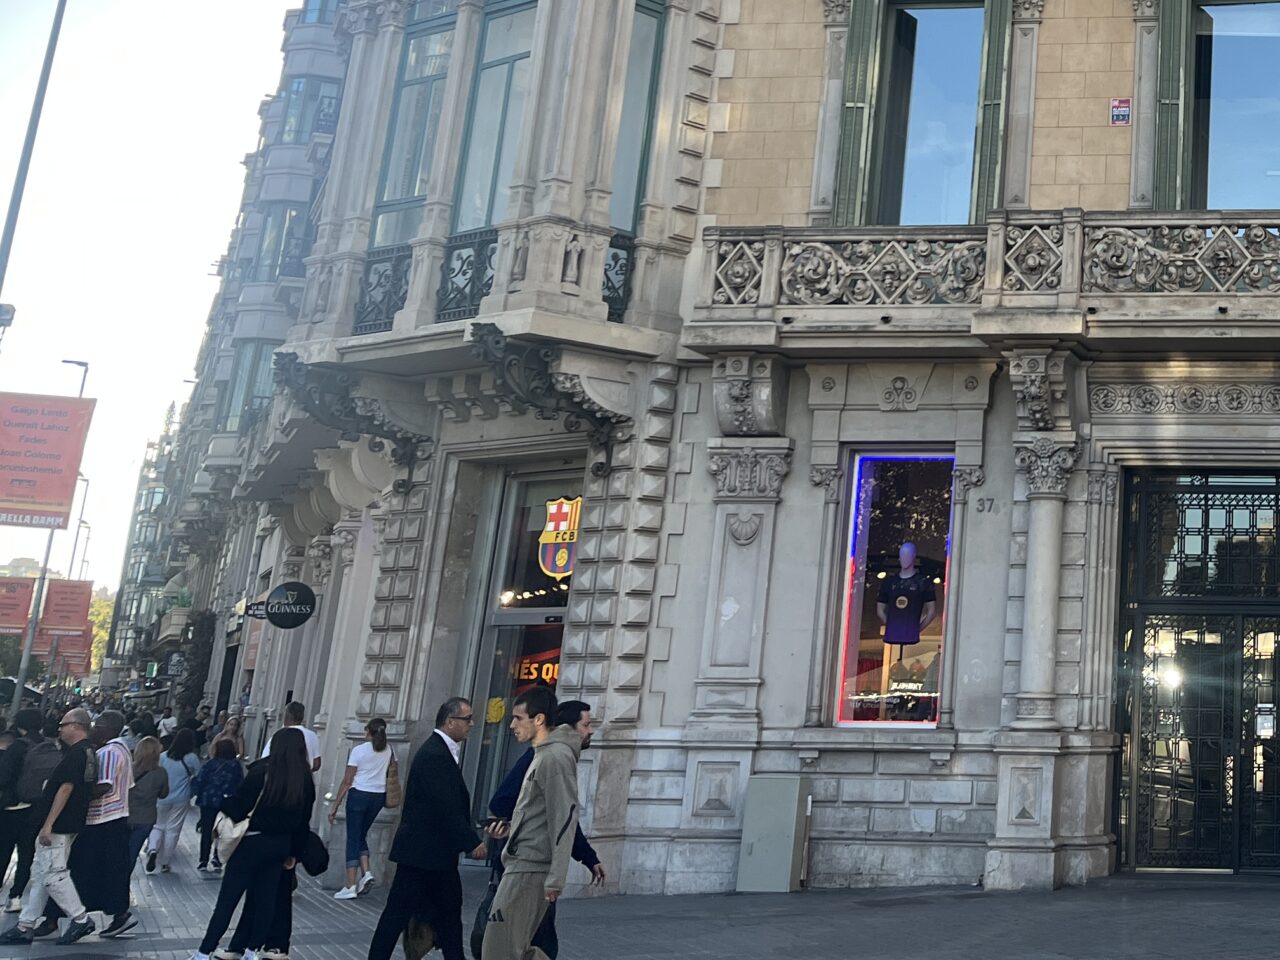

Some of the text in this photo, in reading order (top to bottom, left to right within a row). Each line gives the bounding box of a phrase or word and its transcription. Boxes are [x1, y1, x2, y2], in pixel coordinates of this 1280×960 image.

[976, 497, 995, 513] 37
[32, 515, 64, 526] DAMM
[555, 531, 576, 542] FCB
[267, 602, 311, 614] GUINNESS
